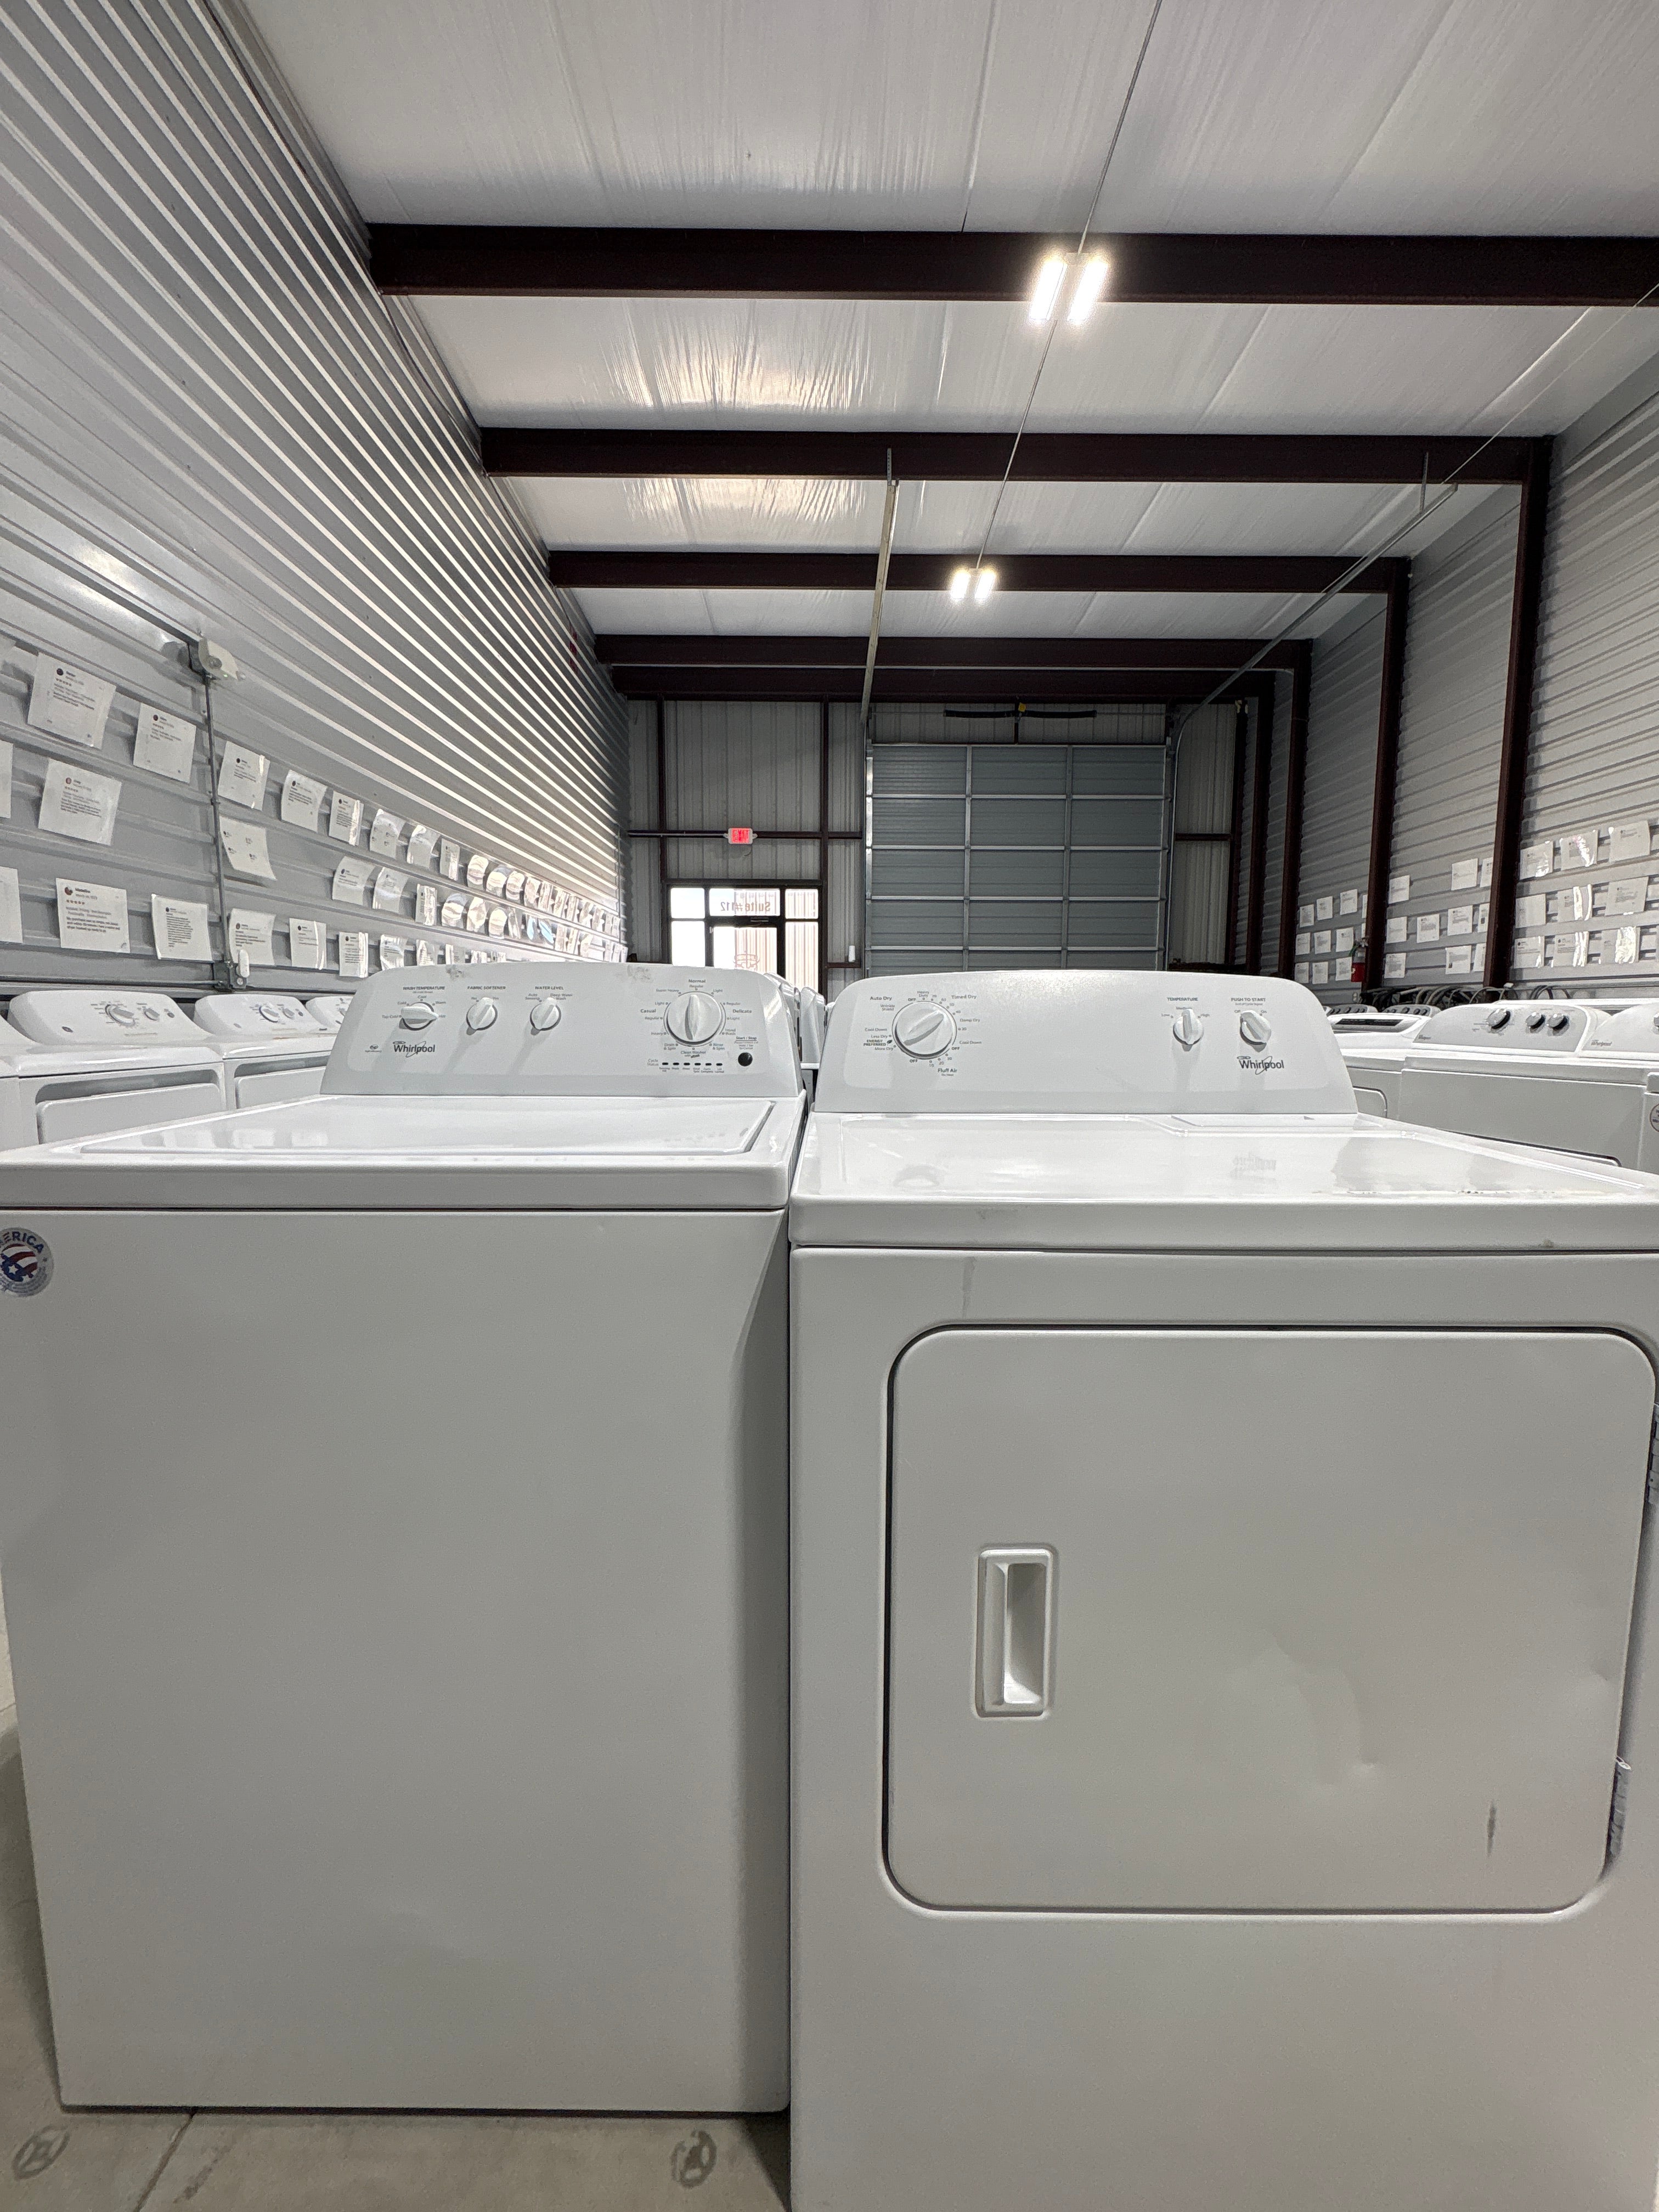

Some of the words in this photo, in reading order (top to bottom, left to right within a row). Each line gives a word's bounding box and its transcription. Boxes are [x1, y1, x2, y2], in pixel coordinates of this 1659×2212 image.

[393, 1043, 436, 1054] Whirlpool
[1238, 1059, 1285, 1072] Whirlpool
[0, 1231, 44, 1254] ERICA
